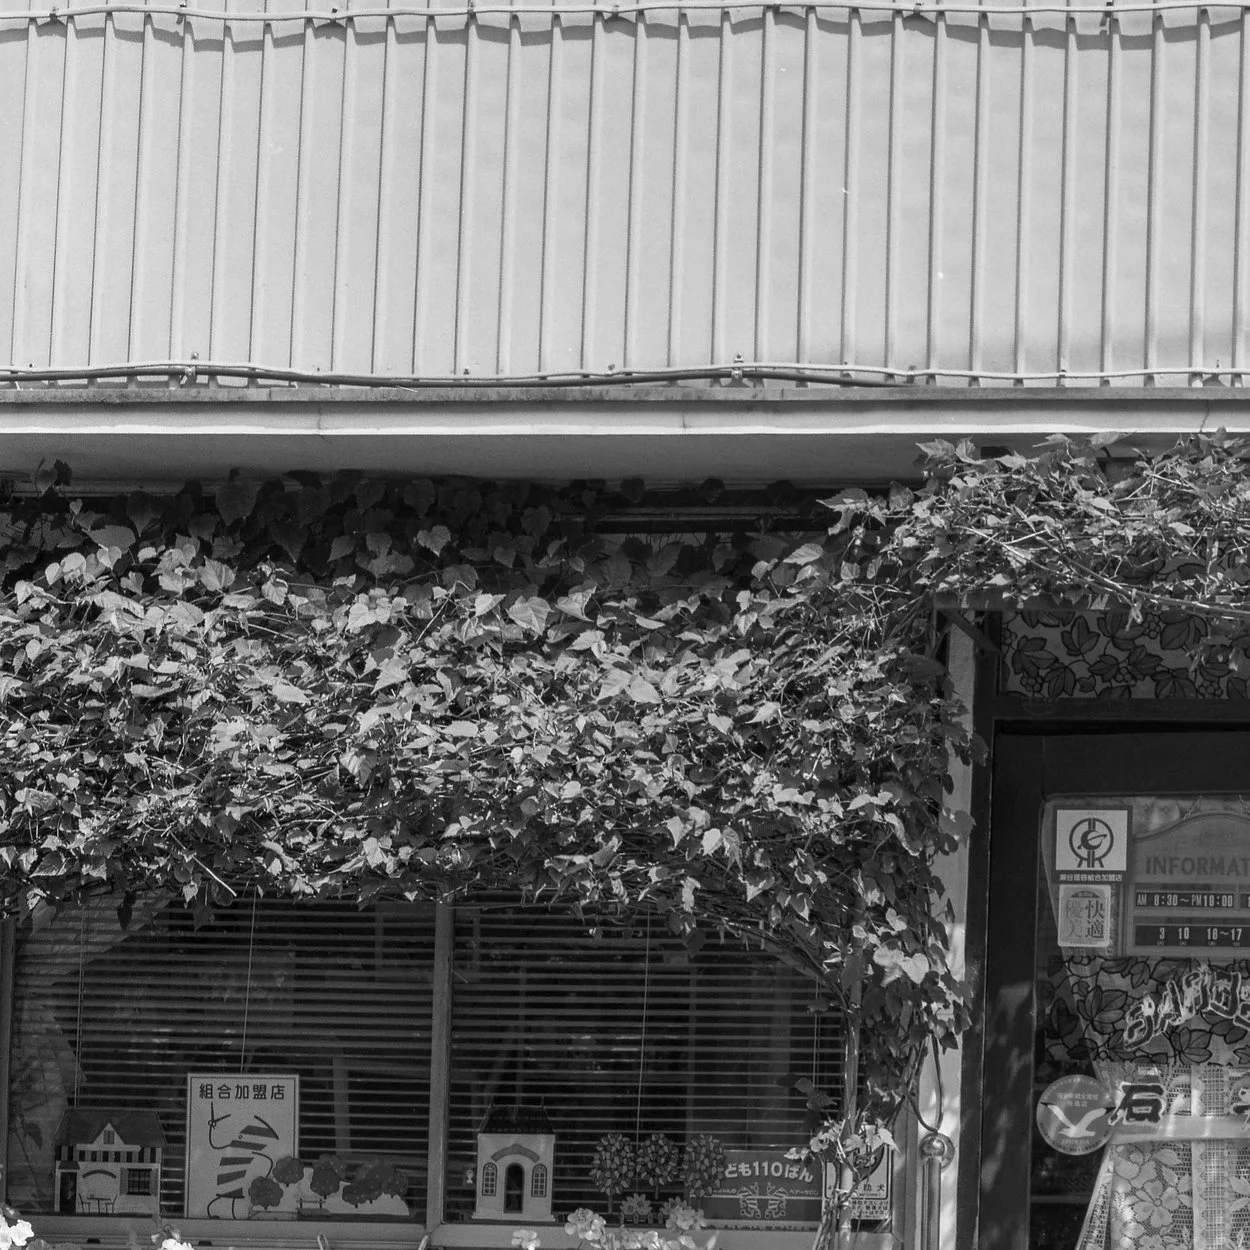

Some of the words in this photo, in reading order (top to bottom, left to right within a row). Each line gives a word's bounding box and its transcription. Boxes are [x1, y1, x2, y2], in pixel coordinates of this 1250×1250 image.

[1136, 894, 1147, 906] AM
[1159, 927, 1165, 939] 3
[1178, 927, 1190, 940] 10
[199, 1083, 285, 1100] 組合加盟店
[725, 1161, 813, 1182] ども110ばん
